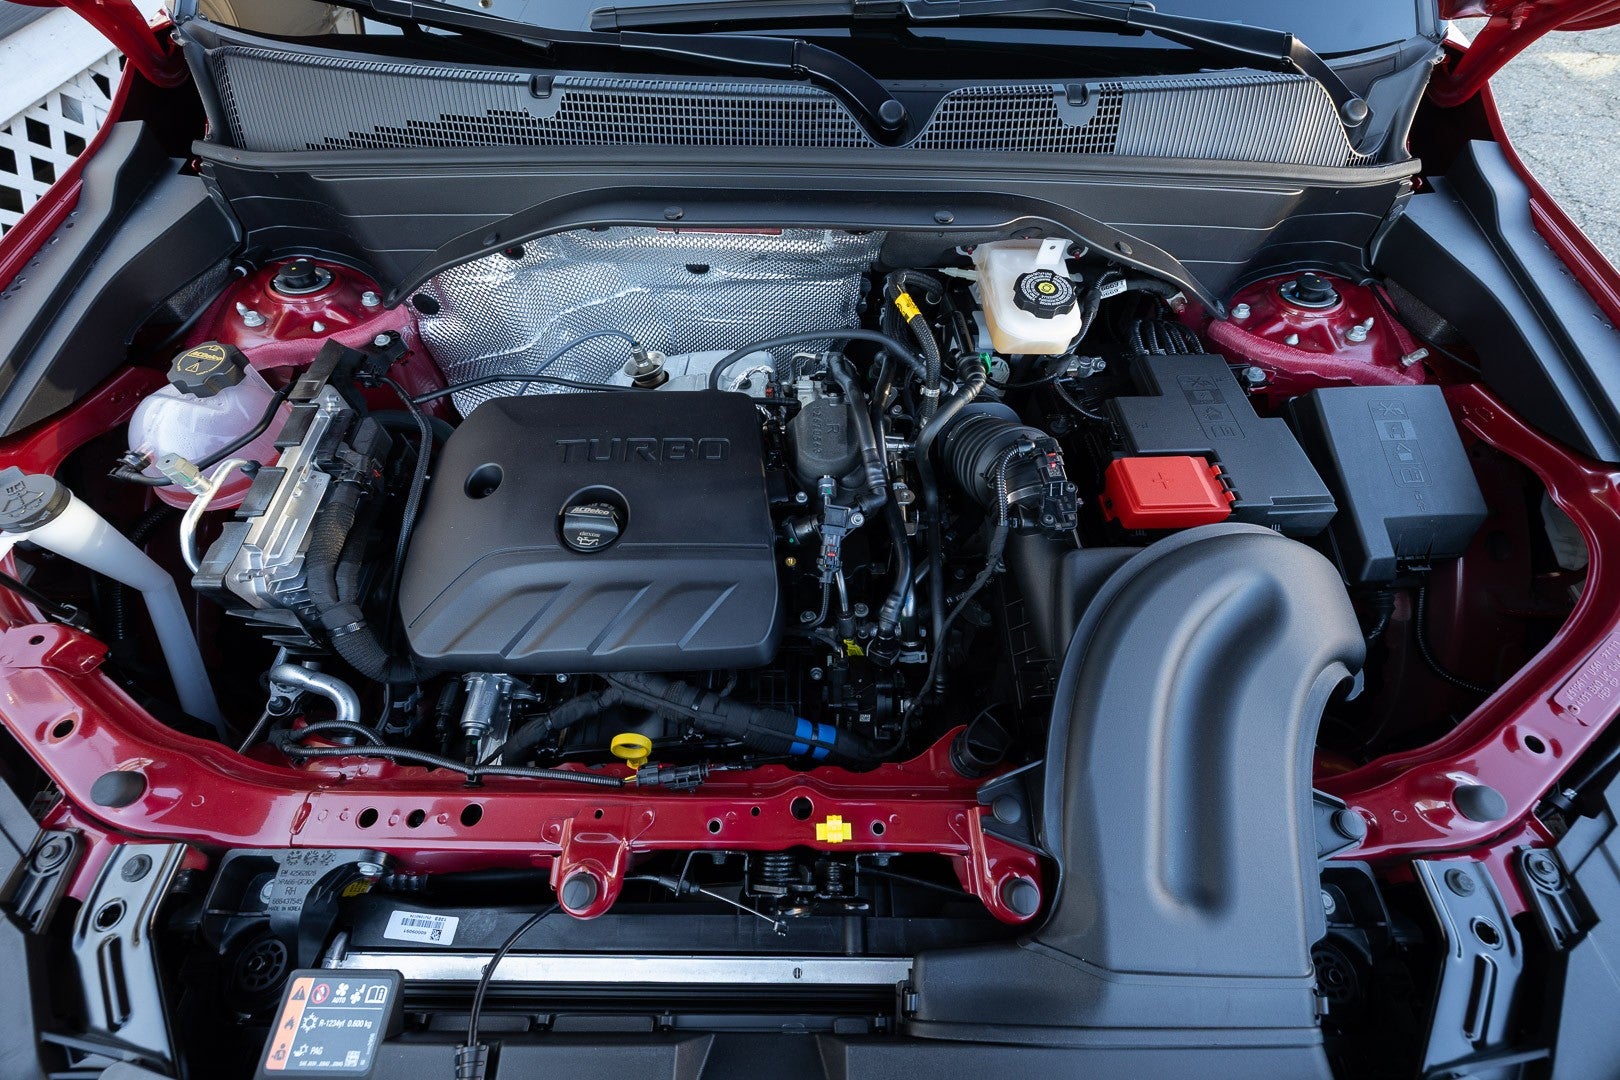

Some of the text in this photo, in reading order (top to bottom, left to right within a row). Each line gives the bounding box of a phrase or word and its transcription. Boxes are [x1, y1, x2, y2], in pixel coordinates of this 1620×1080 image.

[555, 437, 731, 464] TURBO
[570, 507, 610, 516] ACDelco
[285, 887, 297, 895] RH
[331, 996, 346, 1004] AUTO
[309, 1046, 324, 1055] PAG
